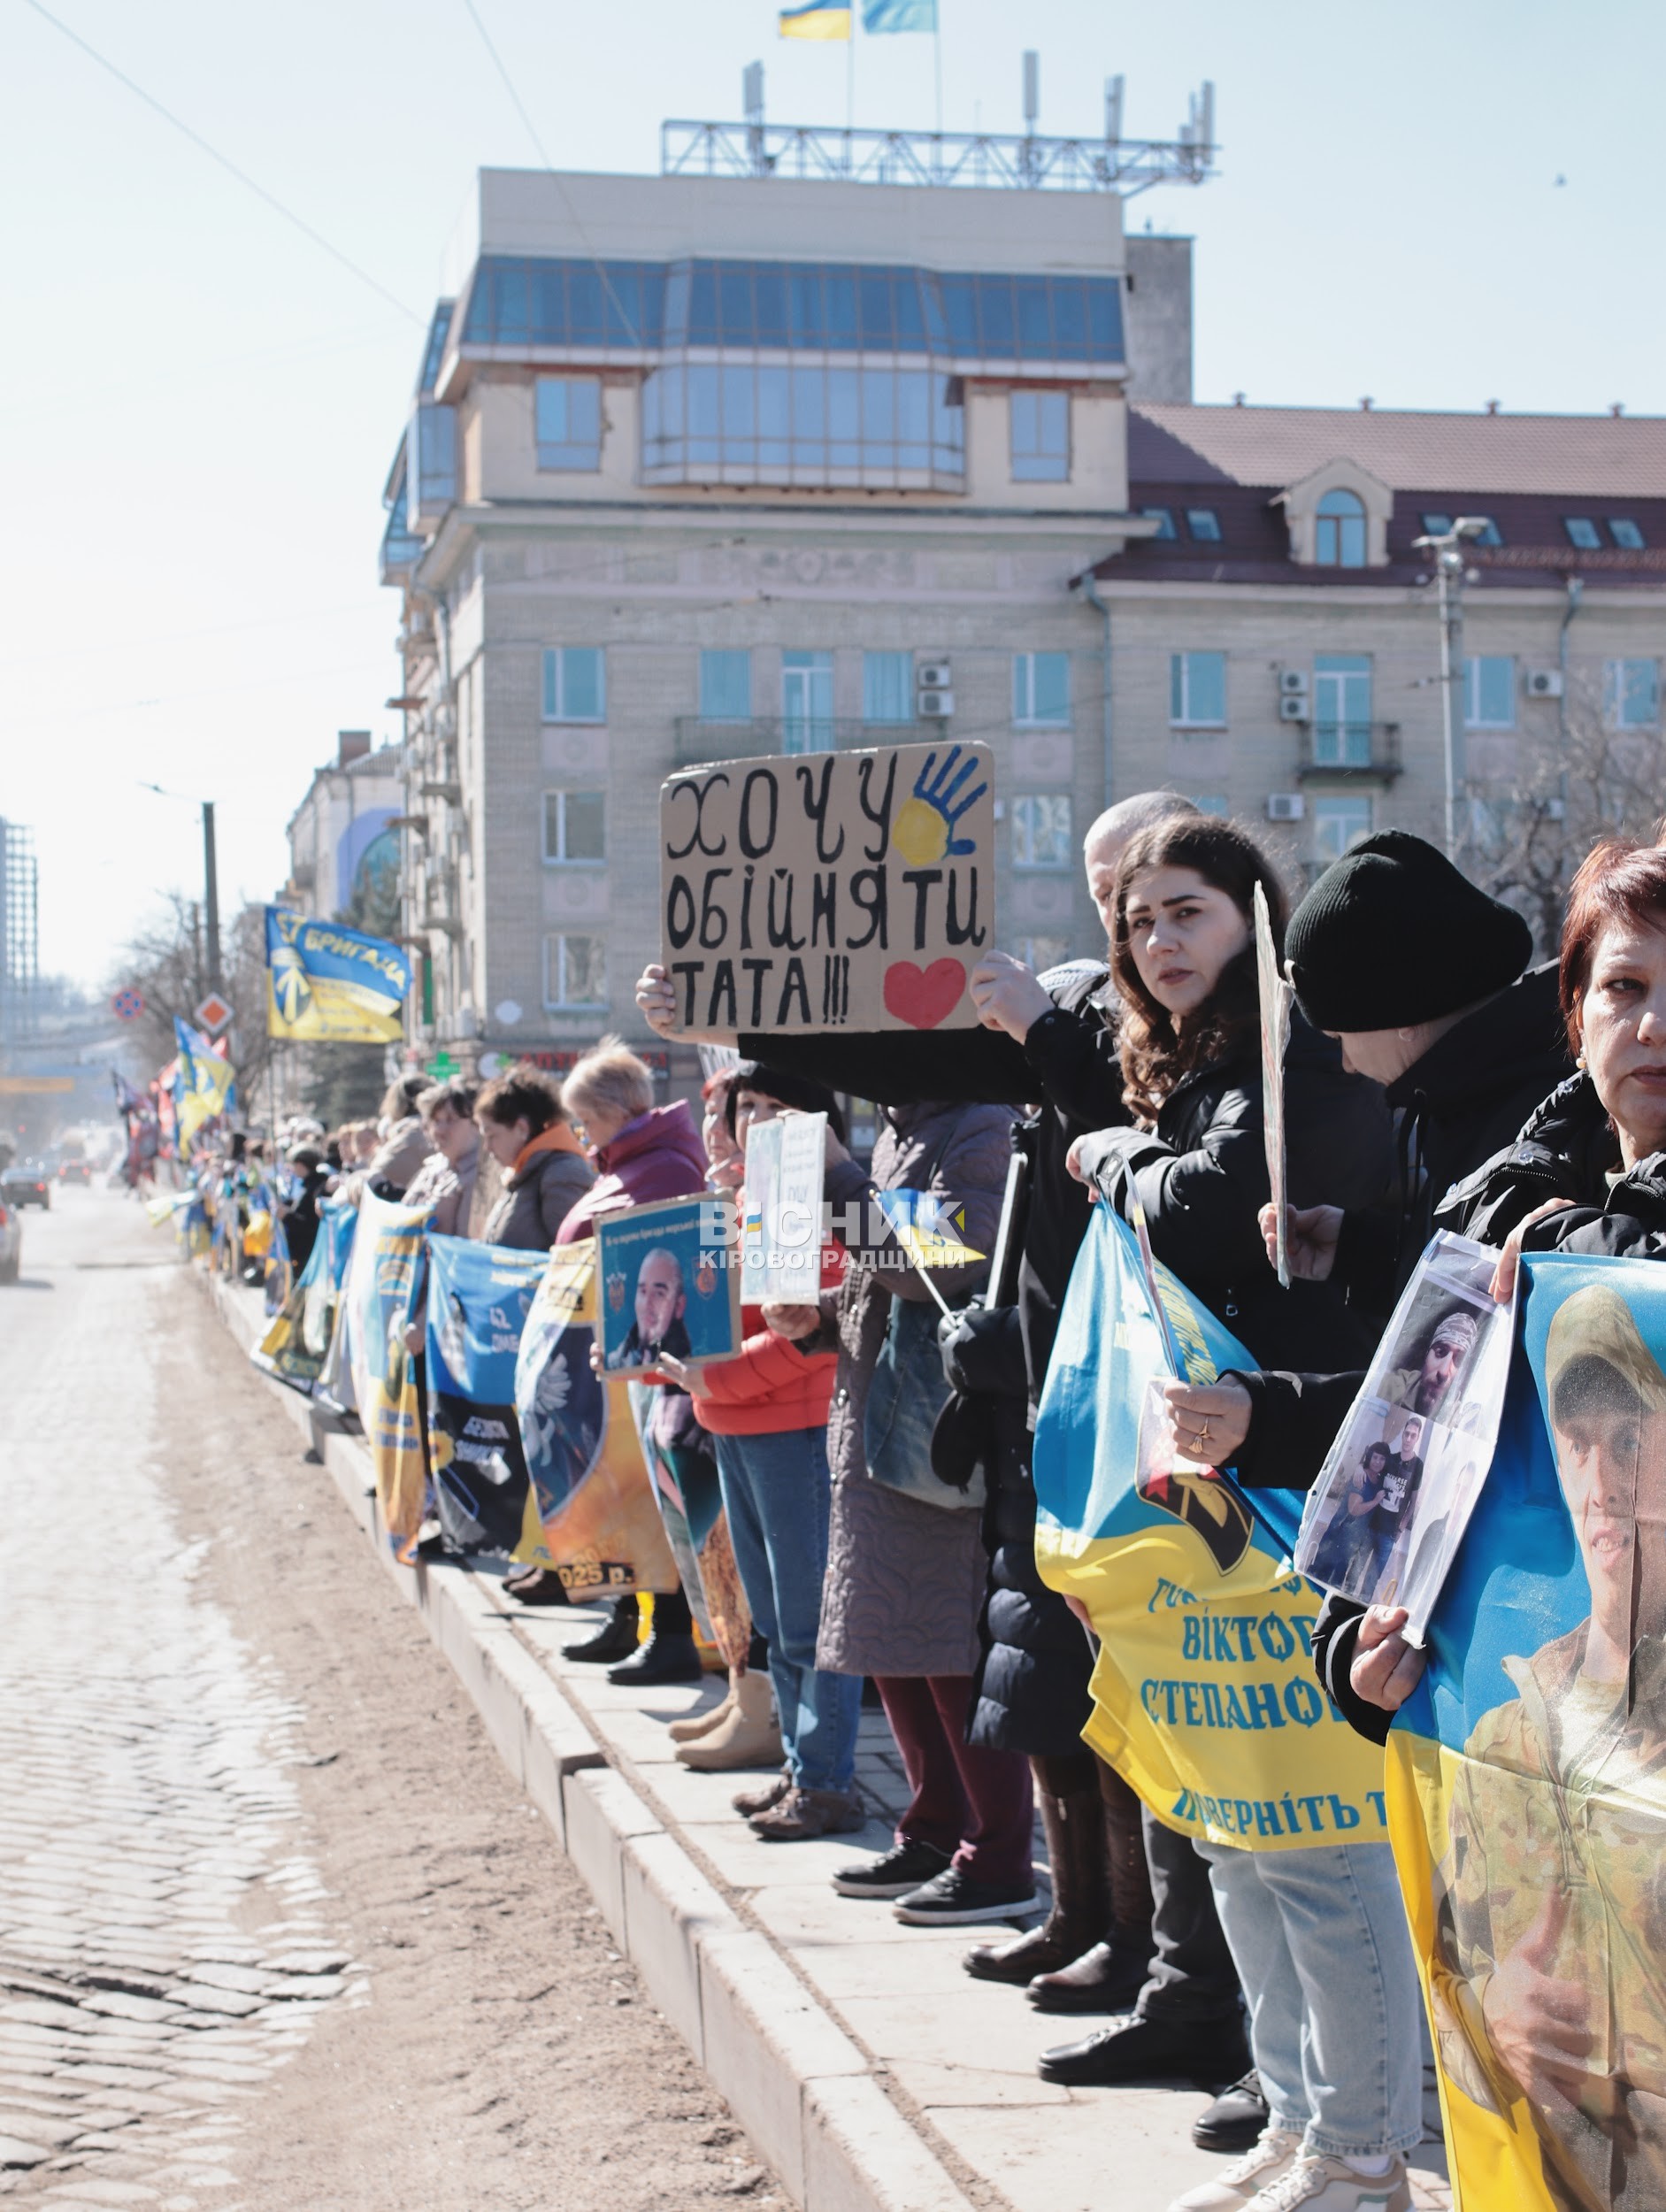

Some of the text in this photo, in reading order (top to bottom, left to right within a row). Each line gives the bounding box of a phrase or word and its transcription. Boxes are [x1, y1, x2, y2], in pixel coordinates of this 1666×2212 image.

[667, 752, 897, 864] ХОЧУ
[667, 864, 987, 950] ОБІЙНЯТИ
[304, 929, 407, 991] БРИГАДА
[672, 955, 849, 1026] ТАТА!!!
[558, 1563, 603, 1588] 025
